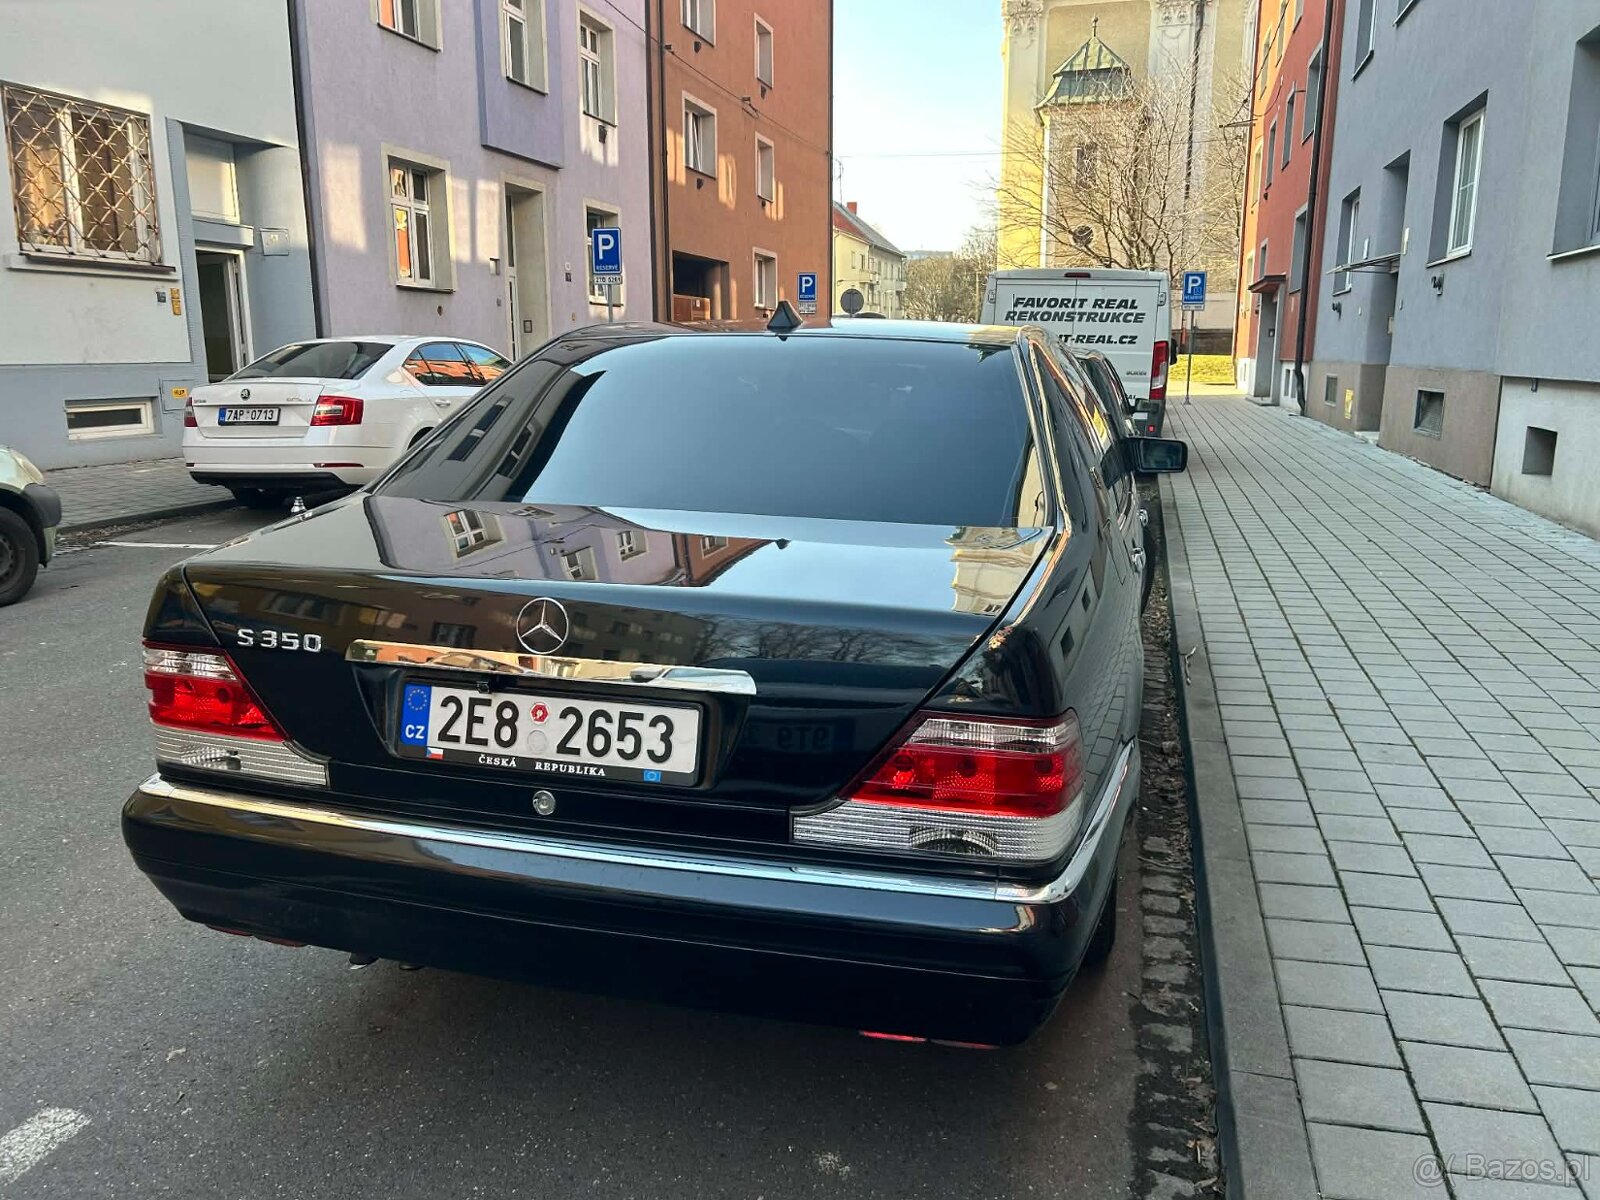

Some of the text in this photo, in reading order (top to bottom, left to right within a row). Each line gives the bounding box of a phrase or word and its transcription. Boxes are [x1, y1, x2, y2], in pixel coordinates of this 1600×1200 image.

[598, 234, 614, 260] P
[801, 276, 813, 293] P
[1187, 275, 1202, 294] P
[1013, 297, 1139, 310] FAVORIT REAL
[1004, 310, 1146, 324] REKONSTRUKCE
[227, 409, 244, 420] 7AP
[251, 409, 274, 420] 0713
[405, 724, 425, 739] CZ
[437, 695, 674, 763] 2E8 2653
[478, 753, 606, 777] ČESKÁ REPUBLIKA
